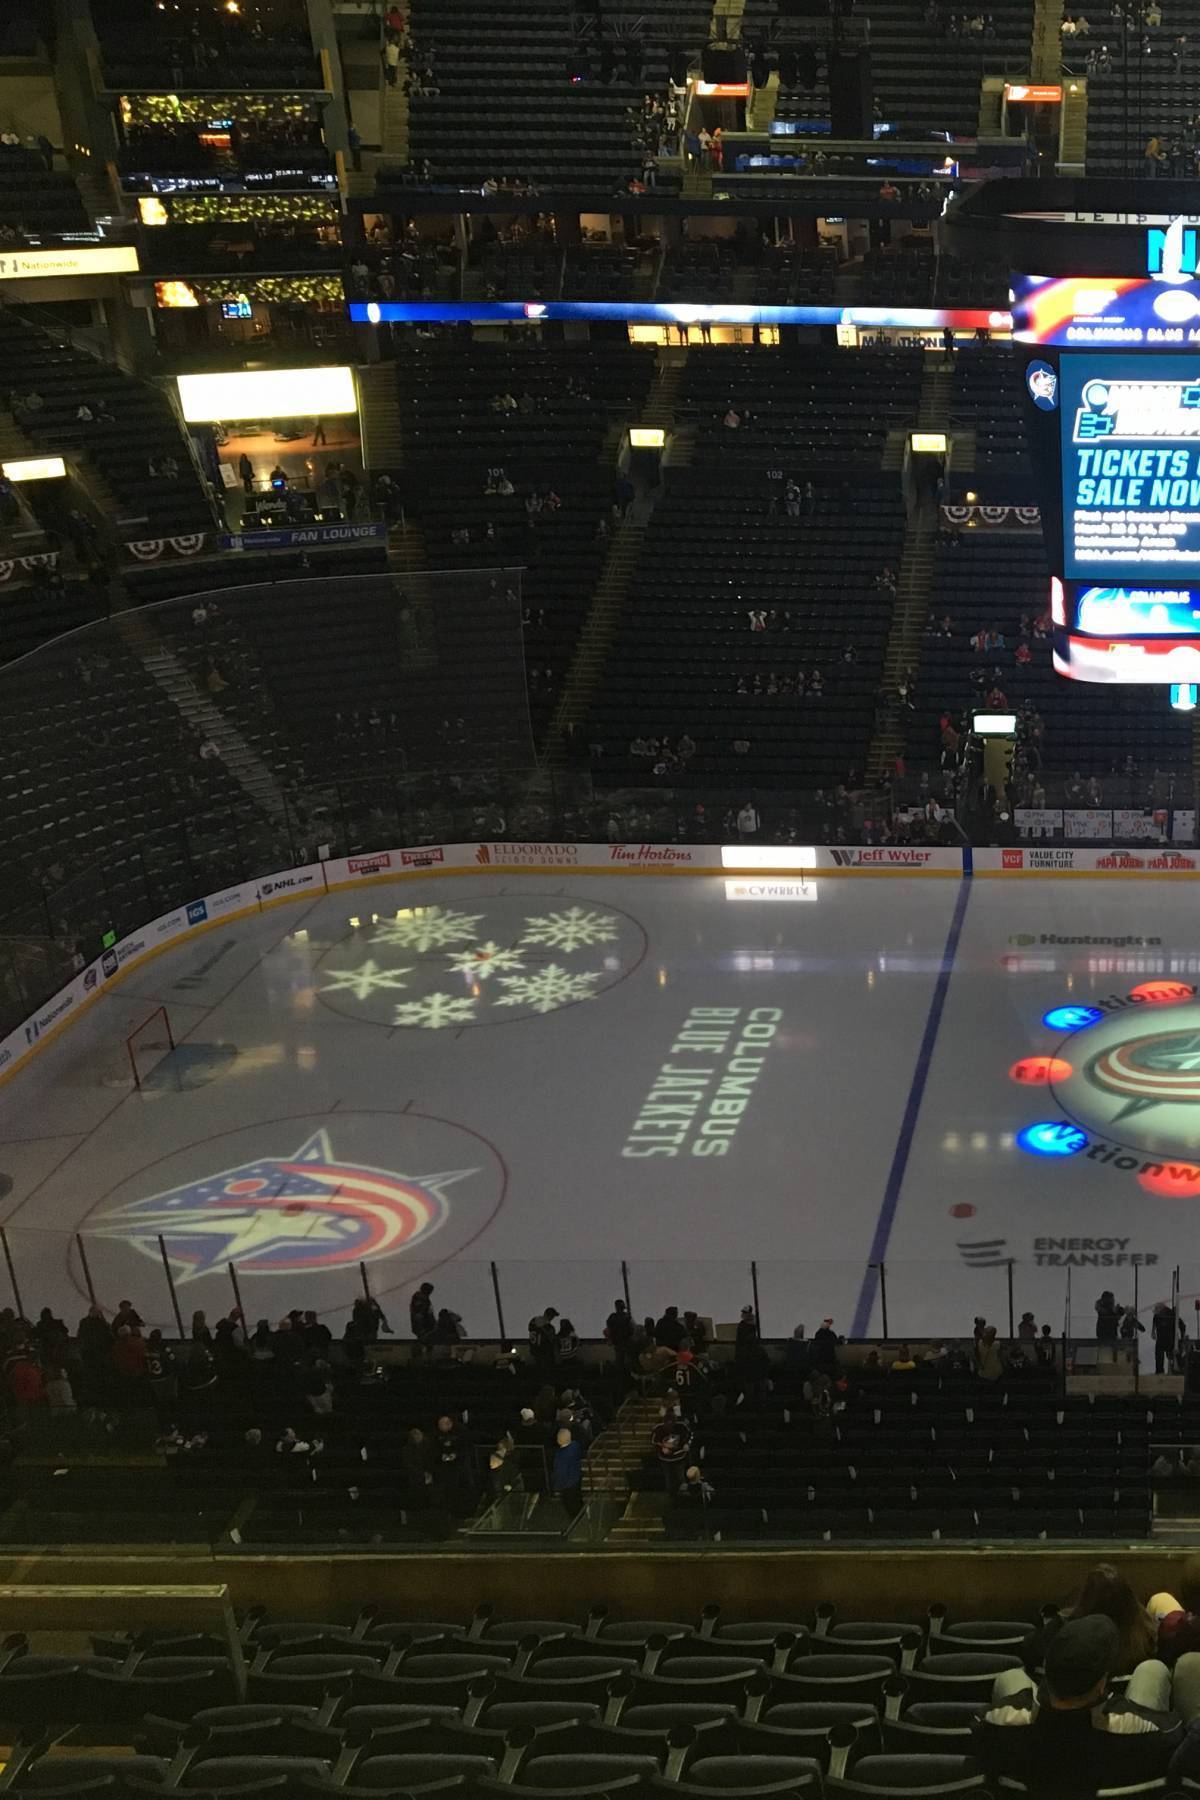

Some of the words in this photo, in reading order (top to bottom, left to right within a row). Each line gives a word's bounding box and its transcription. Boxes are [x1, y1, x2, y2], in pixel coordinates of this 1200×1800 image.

[21, 260, 78, 271] Nationwide
[1077, 449, 1190, 478] TICKETS
[487, 468, 505, 478] 101
[766, 470, 783, 480] 102
[1075, 479, 1145, 507] SALE
[290, 531, 319, 544] FAN
[322, 526, 377, 541] LOUNGE
[493, 844, 578, 855] ELDORADO
[608, 844, 635, 860] Tim
[638, 844, 692, 861] Hortons
[858, 849, 885, 862] Jeff
[888, 849, 932, 863] Wyler
[1029, 851, 1053, 860] VALUE
[1055, 851, 1074, 860] CITY
[1003, 856, 1022, 865] VCF
[1029, 860, 1074, 869] FURNITURE
[188, 906, 205, 919] IGS
[1039, 934, 1162, 947] Huntington
[670, 1007, 742, 1054] BLUE
[691, 1007, 784, 1157] COLUMBUS
[621, 1063, 715, 1158] JACKETS
[1033, 1237, 1131, 1251] ENERGY
[1033, 1253, 1159, 1267] TRANSFER
[675, 1369, 691, 1387] 61
